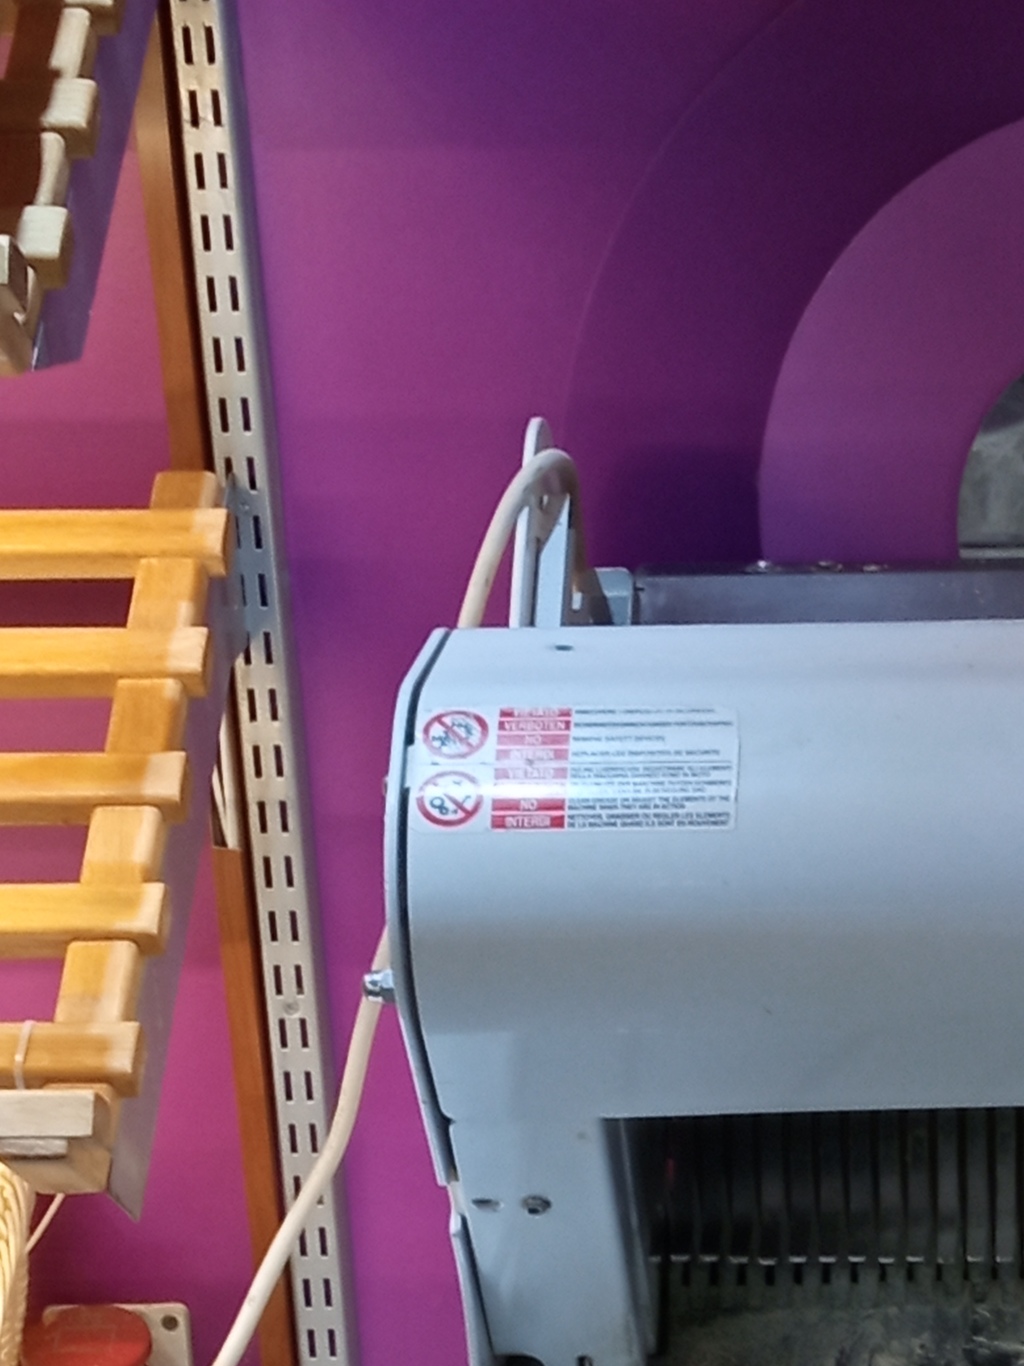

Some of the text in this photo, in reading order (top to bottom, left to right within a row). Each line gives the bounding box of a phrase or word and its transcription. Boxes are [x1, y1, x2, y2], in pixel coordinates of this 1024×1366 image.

[504, 719, 565, 731] VERBOTEN
[524, 735, 542, 746] NO
[519, 799, 538, 811] NO
